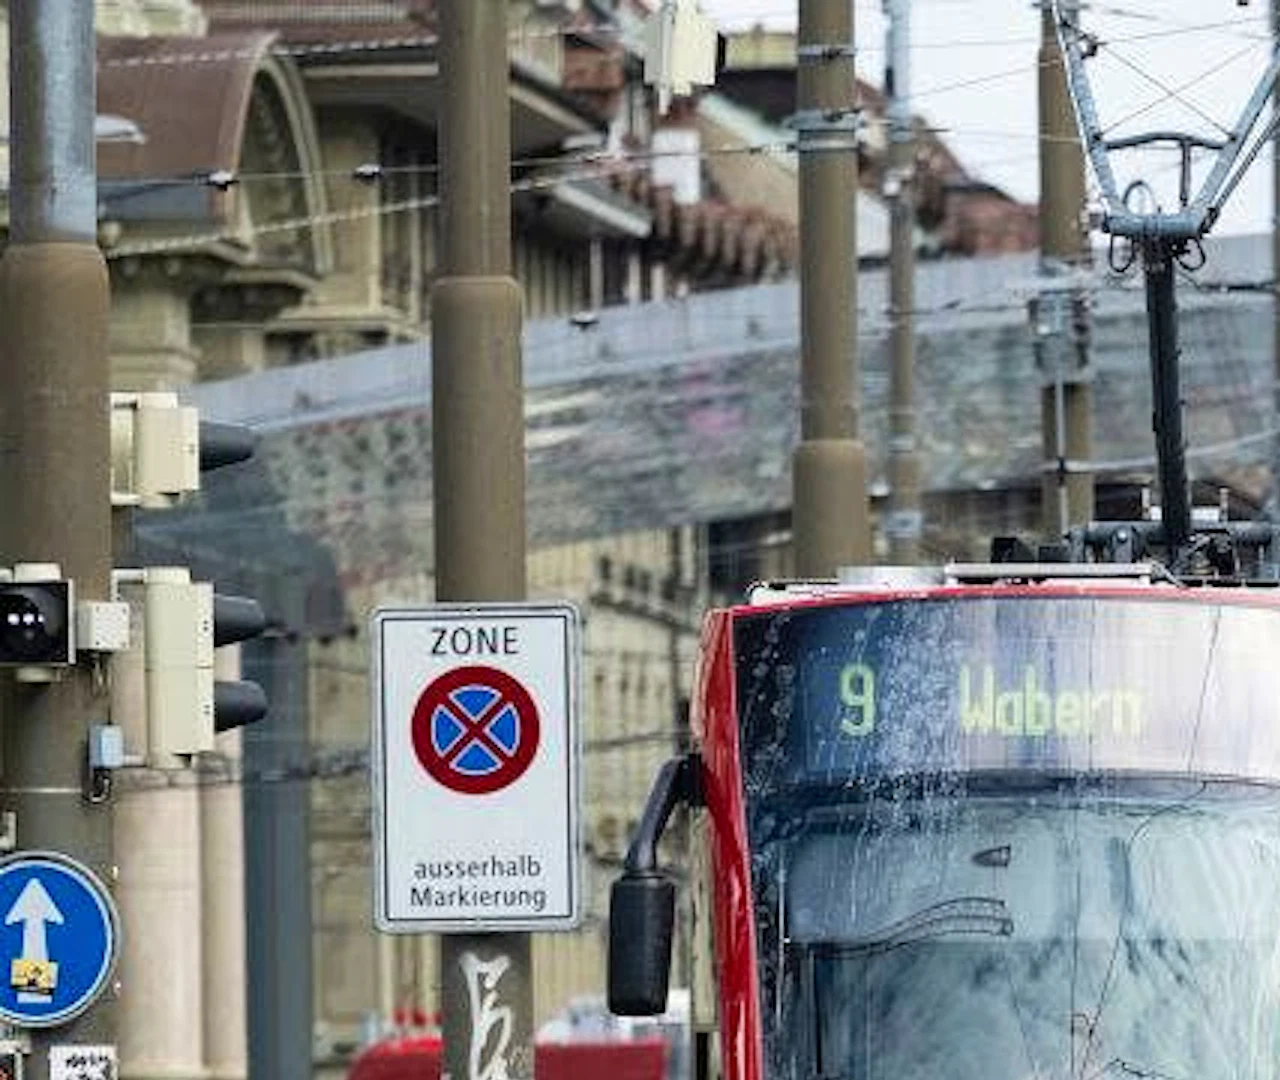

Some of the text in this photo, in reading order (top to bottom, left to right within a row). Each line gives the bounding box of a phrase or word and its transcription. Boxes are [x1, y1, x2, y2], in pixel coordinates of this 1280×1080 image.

[431, 627, 519, 655] ZONE
[842, 664, 1150, 737] 9 Wabern
[414, 855, 541, 880] ausserhalb
[411, 887, 547, 911] Markierung
